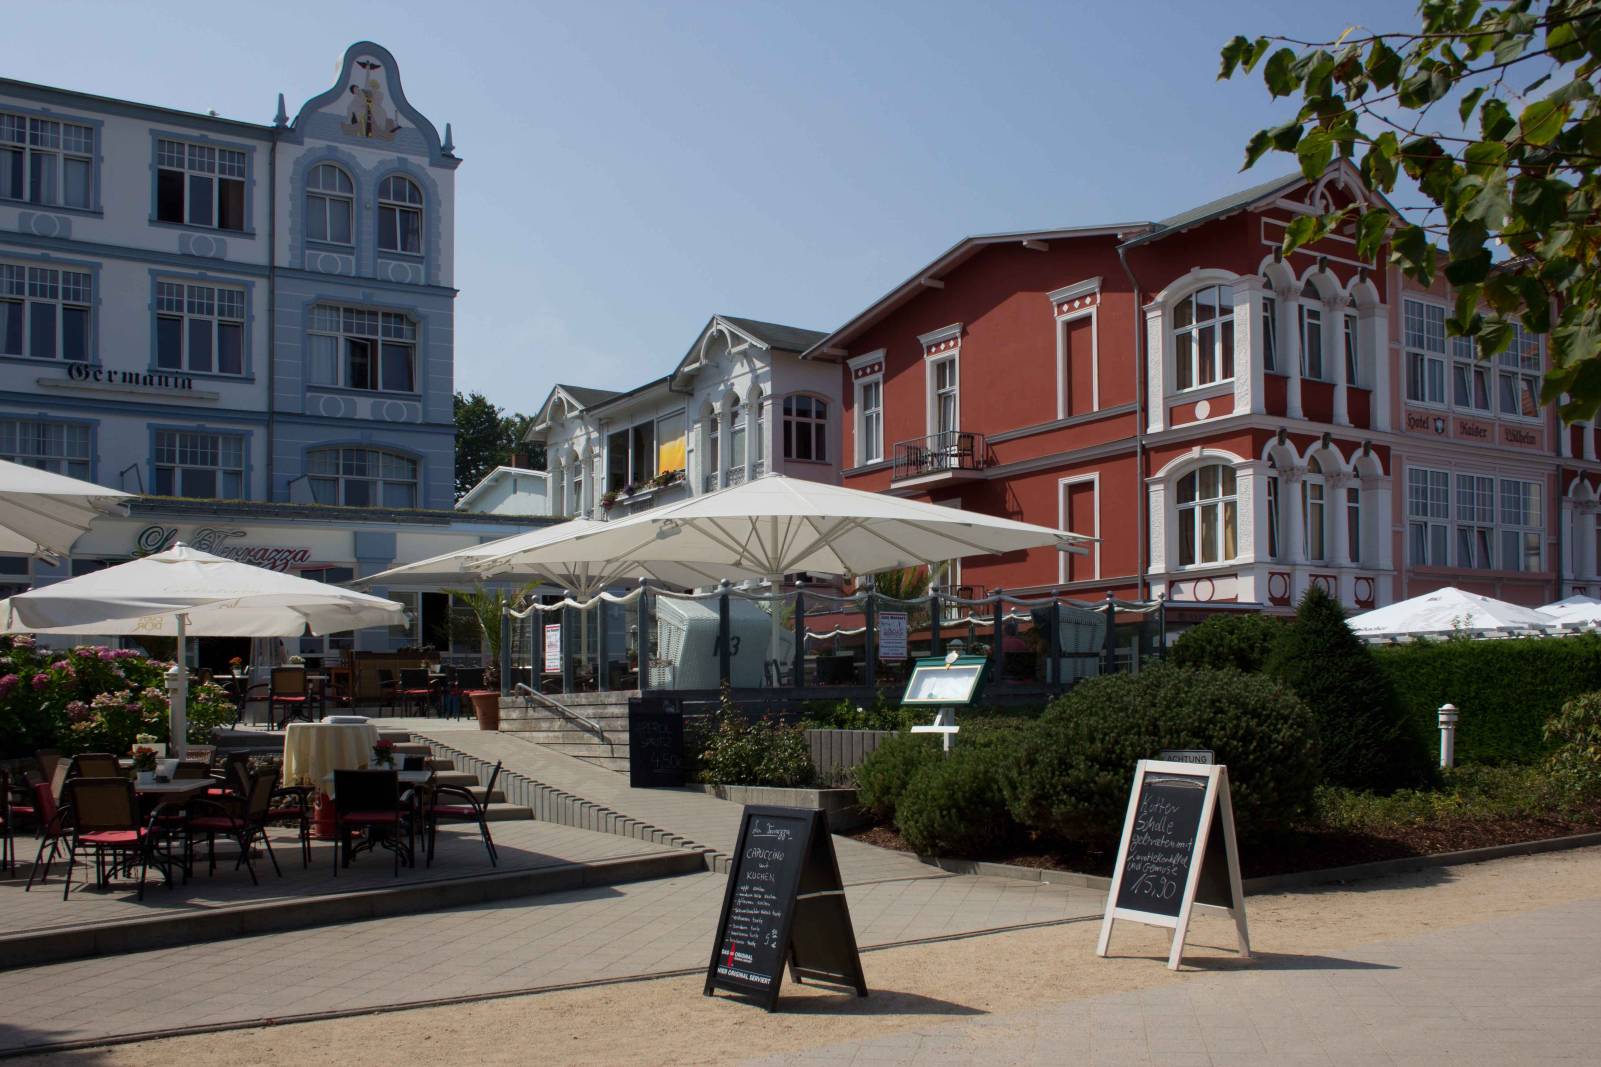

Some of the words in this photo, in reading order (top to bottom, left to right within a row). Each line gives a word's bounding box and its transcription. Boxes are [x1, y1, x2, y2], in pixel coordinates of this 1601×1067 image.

[67, 361, 192, 390] Germania
[1460, 421, 1487, 438] Kaiser
[1505, 427, 1537, 445] Wilhelm
[1167, 754, 1207, 763] ACHTUNG
[1130, 873, 1177, 899] 15,90
